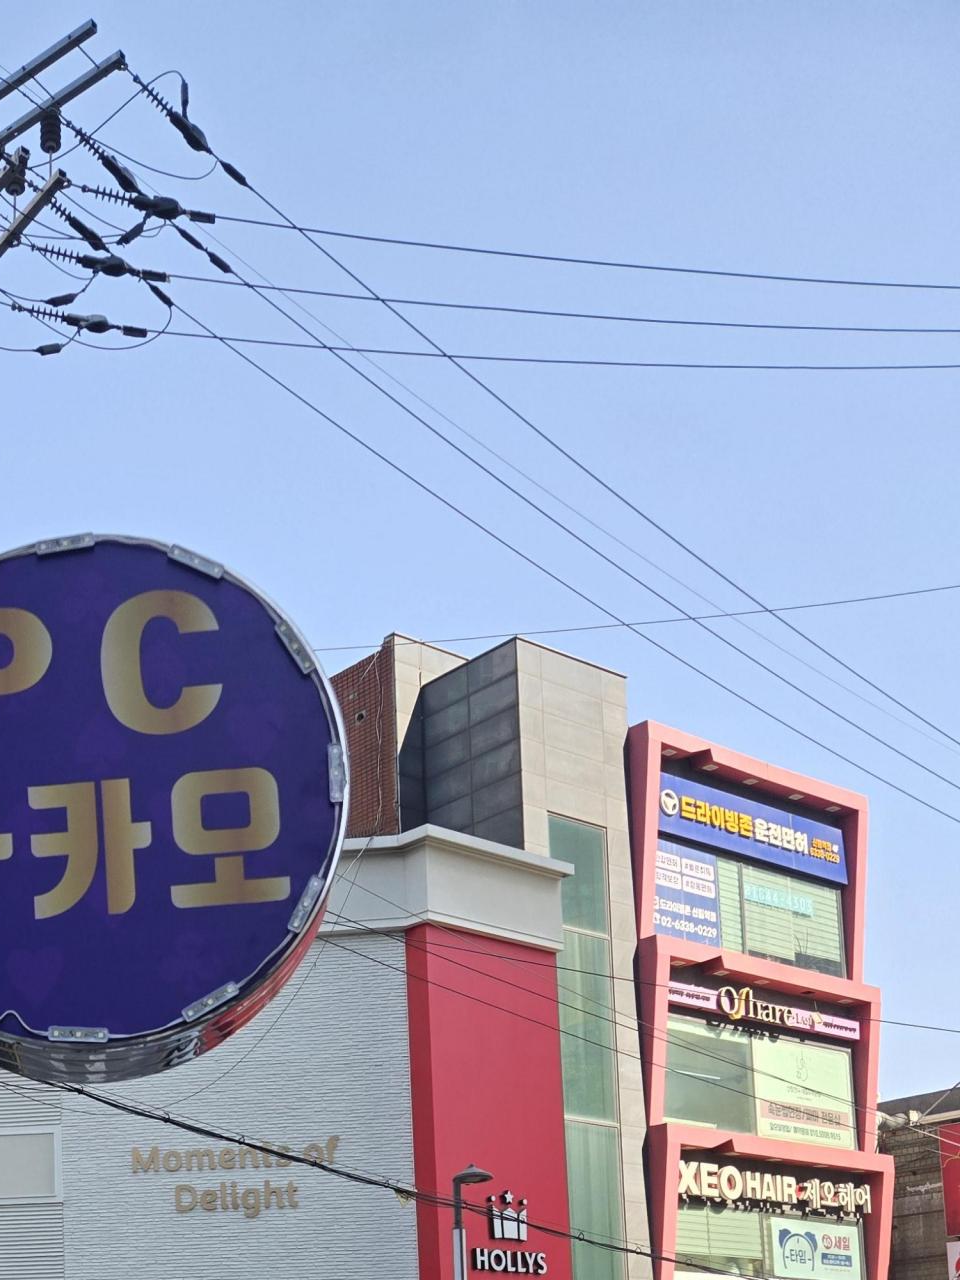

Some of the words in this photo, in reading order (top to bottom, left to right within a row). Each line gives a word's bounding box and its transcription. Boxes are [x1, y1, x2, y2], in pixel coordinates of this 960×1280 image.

[681, 795, 753, 838] 드라이빙존
[754, 818, 808, 854] 운전면허
[131, 1141, 293, 1173] Moments
[303, 1135, 340, 1165] of
[175, 1180, 299, 1218] Delight
[678, 1160, 743, 1201] XEO
[743, 1171, 798, 1204] HAIR
[799, 1178, 871, 1214] 제오헤어
[475, 1247, 548, 1275] HOLLYS
[790, 1249, 806, 1264] 타임
